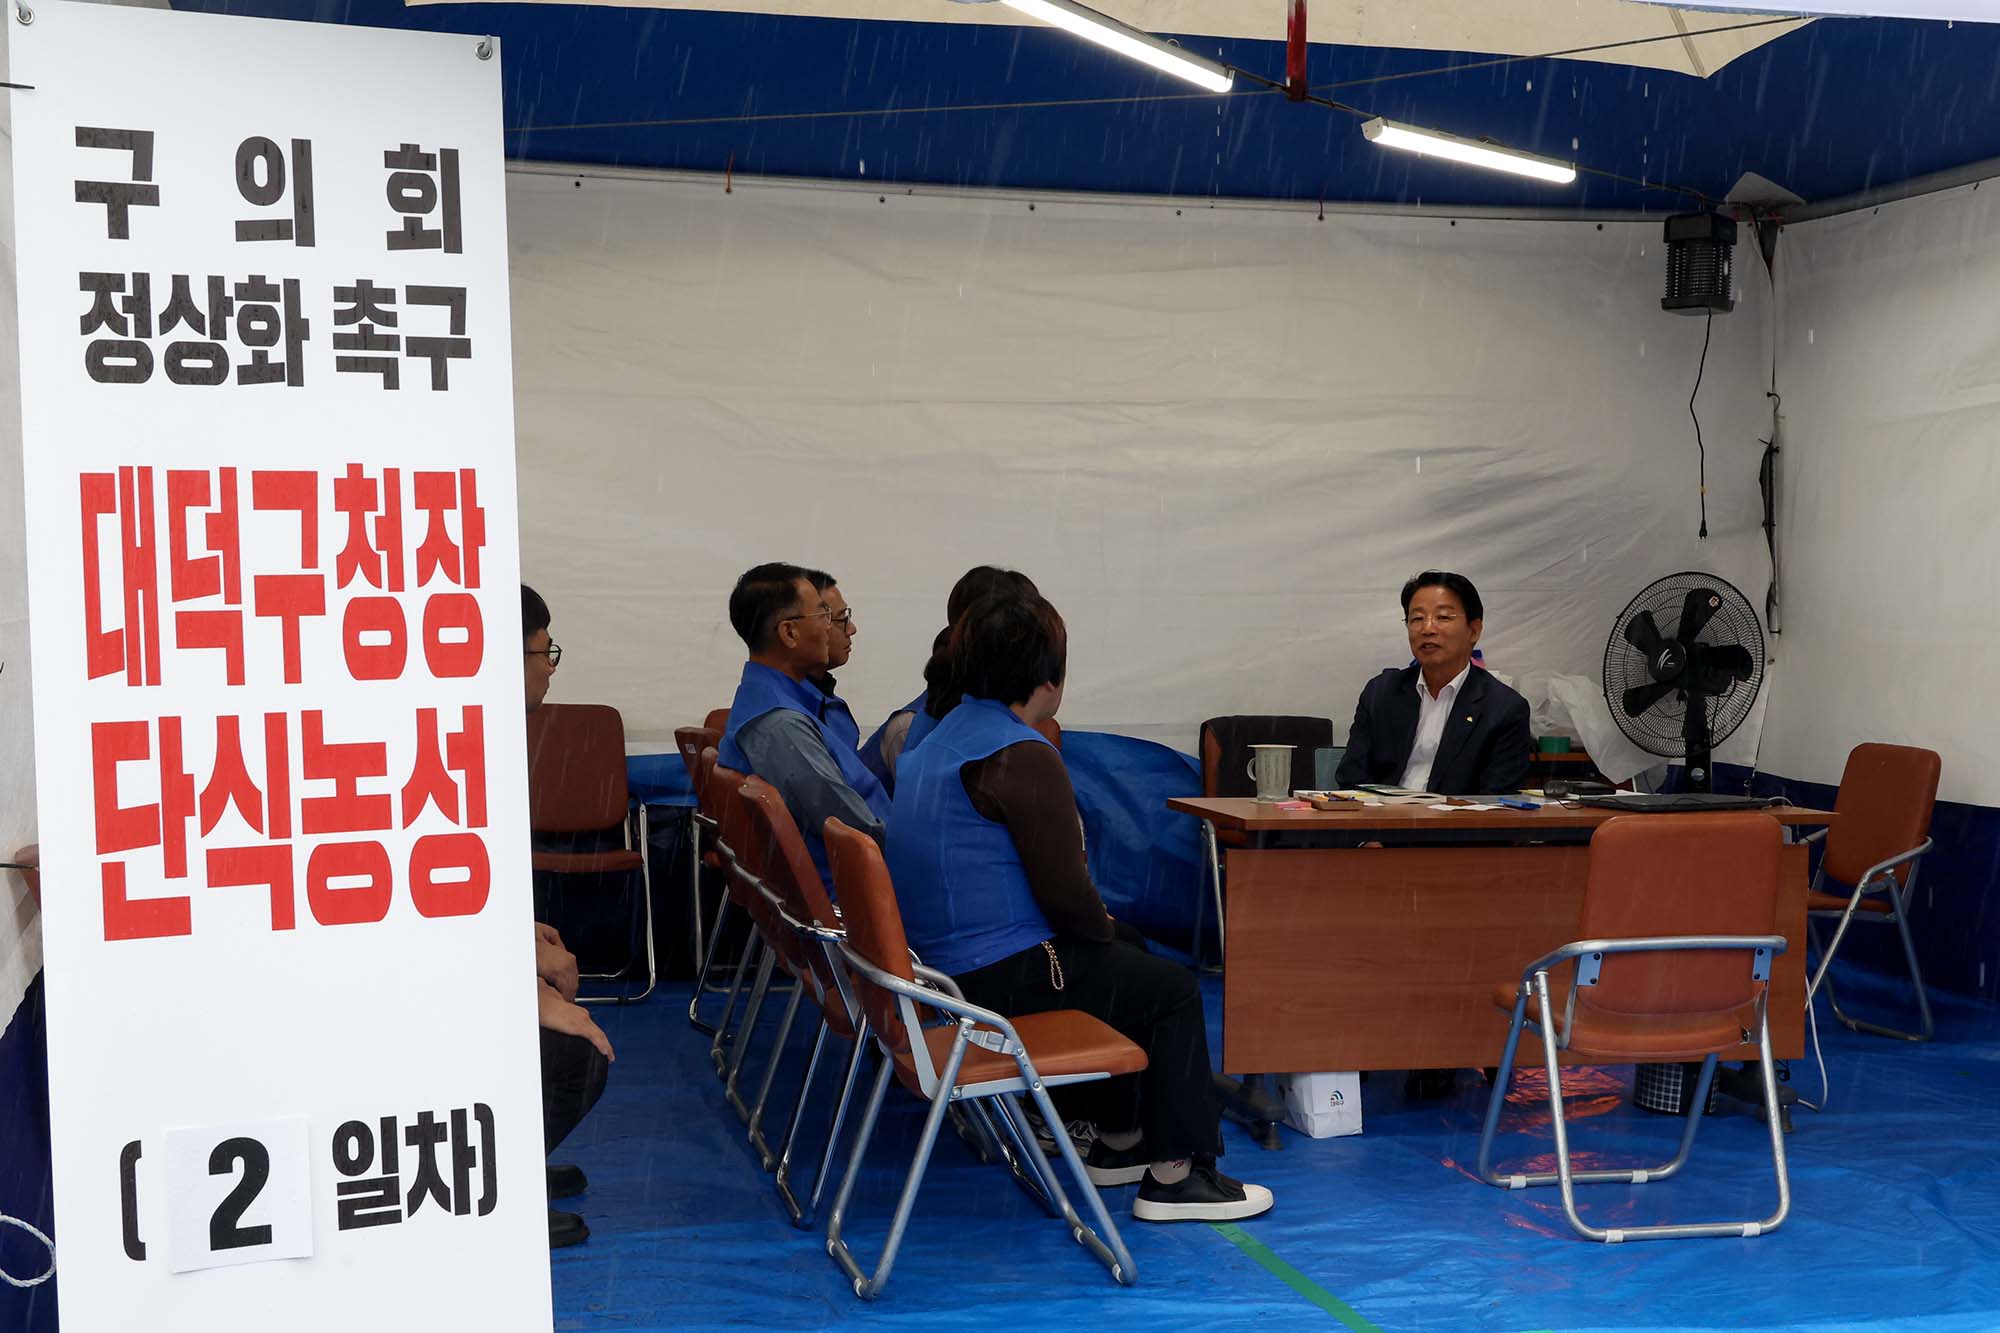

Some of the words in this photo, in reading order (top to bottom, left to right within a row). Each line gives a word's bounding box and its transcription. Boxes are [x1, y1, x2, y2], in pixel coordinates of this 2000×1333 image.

[79, 272, 309, 387] 정상화
[333, 279, 471, 391] 촉구
[80, 464, 485, 686] 대덕구청장
[91, 705, 490, 941] 단식농성
